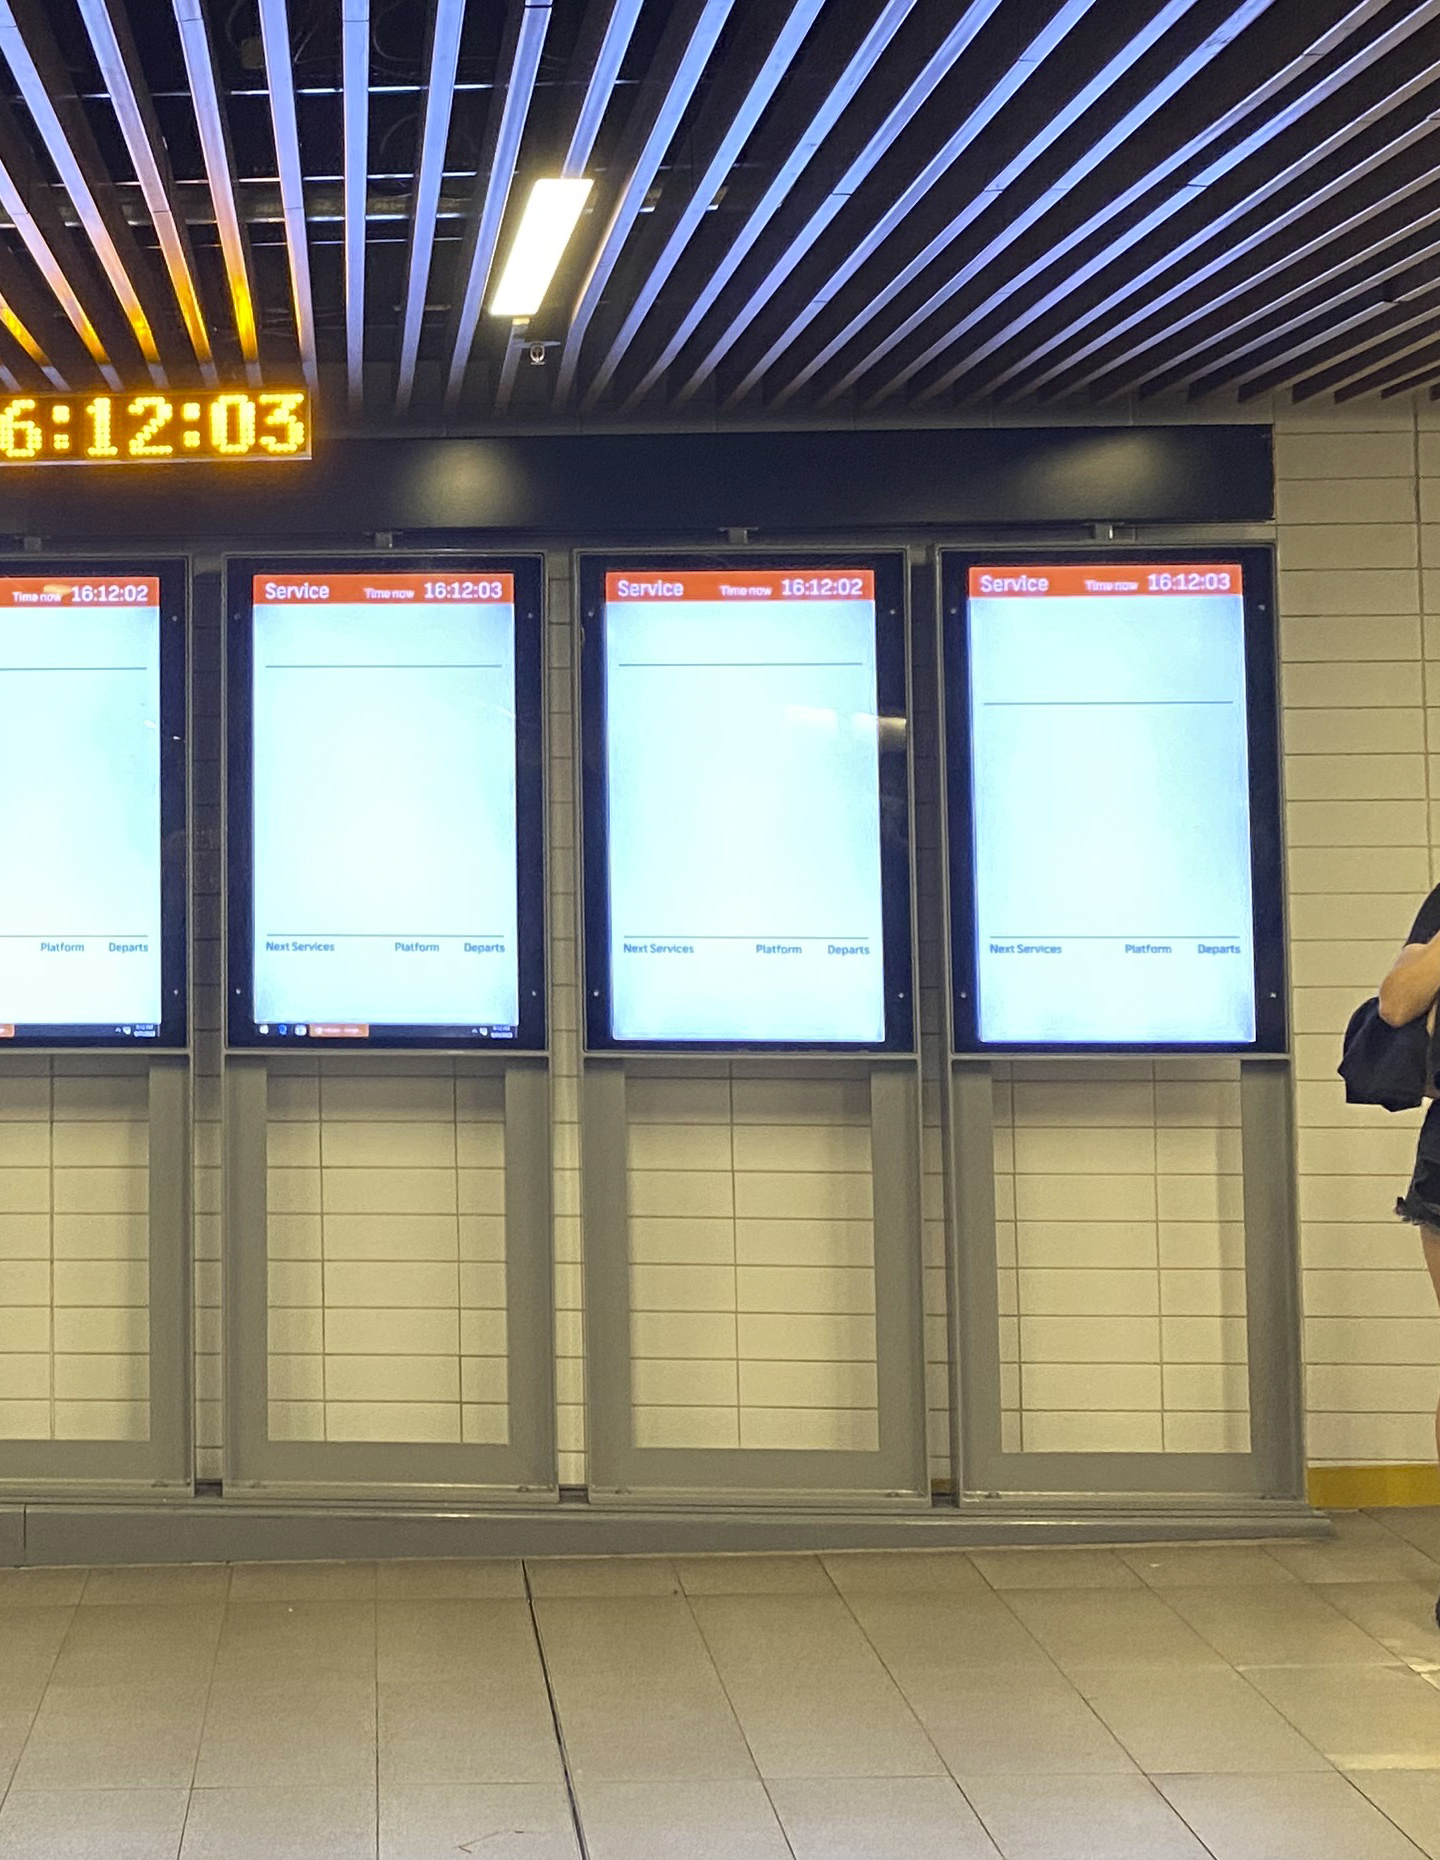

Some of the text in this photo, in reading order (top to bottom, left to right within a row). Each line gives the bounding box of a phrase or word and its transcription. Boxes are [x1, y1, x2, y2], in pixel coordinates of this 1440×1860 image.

[618, 580, 683, 597] Service
[720, 578, 863, 596] Time now 16:12:02
[980, 575, 1049, 592] Service
[1085, 573, 1230, 590] Time now 16:12:03
[12, 585, 148, 602] Time now 16:12:02
[265, 582, 329, 599] Service
[364, 582, 502, 598] Time now 16:12:03
[40, 943, 148, 953] Platform Departs
[266, 942, 334, 952] Next Services
[395, 942, 505, 954] Platform Departs
[623, 944, 694, 954] Next Services
[756, 944, 870, 955] Platform Departs
[990, 944, 1062, 954] Next Services
[1125, 944, 1240, 955] Platform Departs
